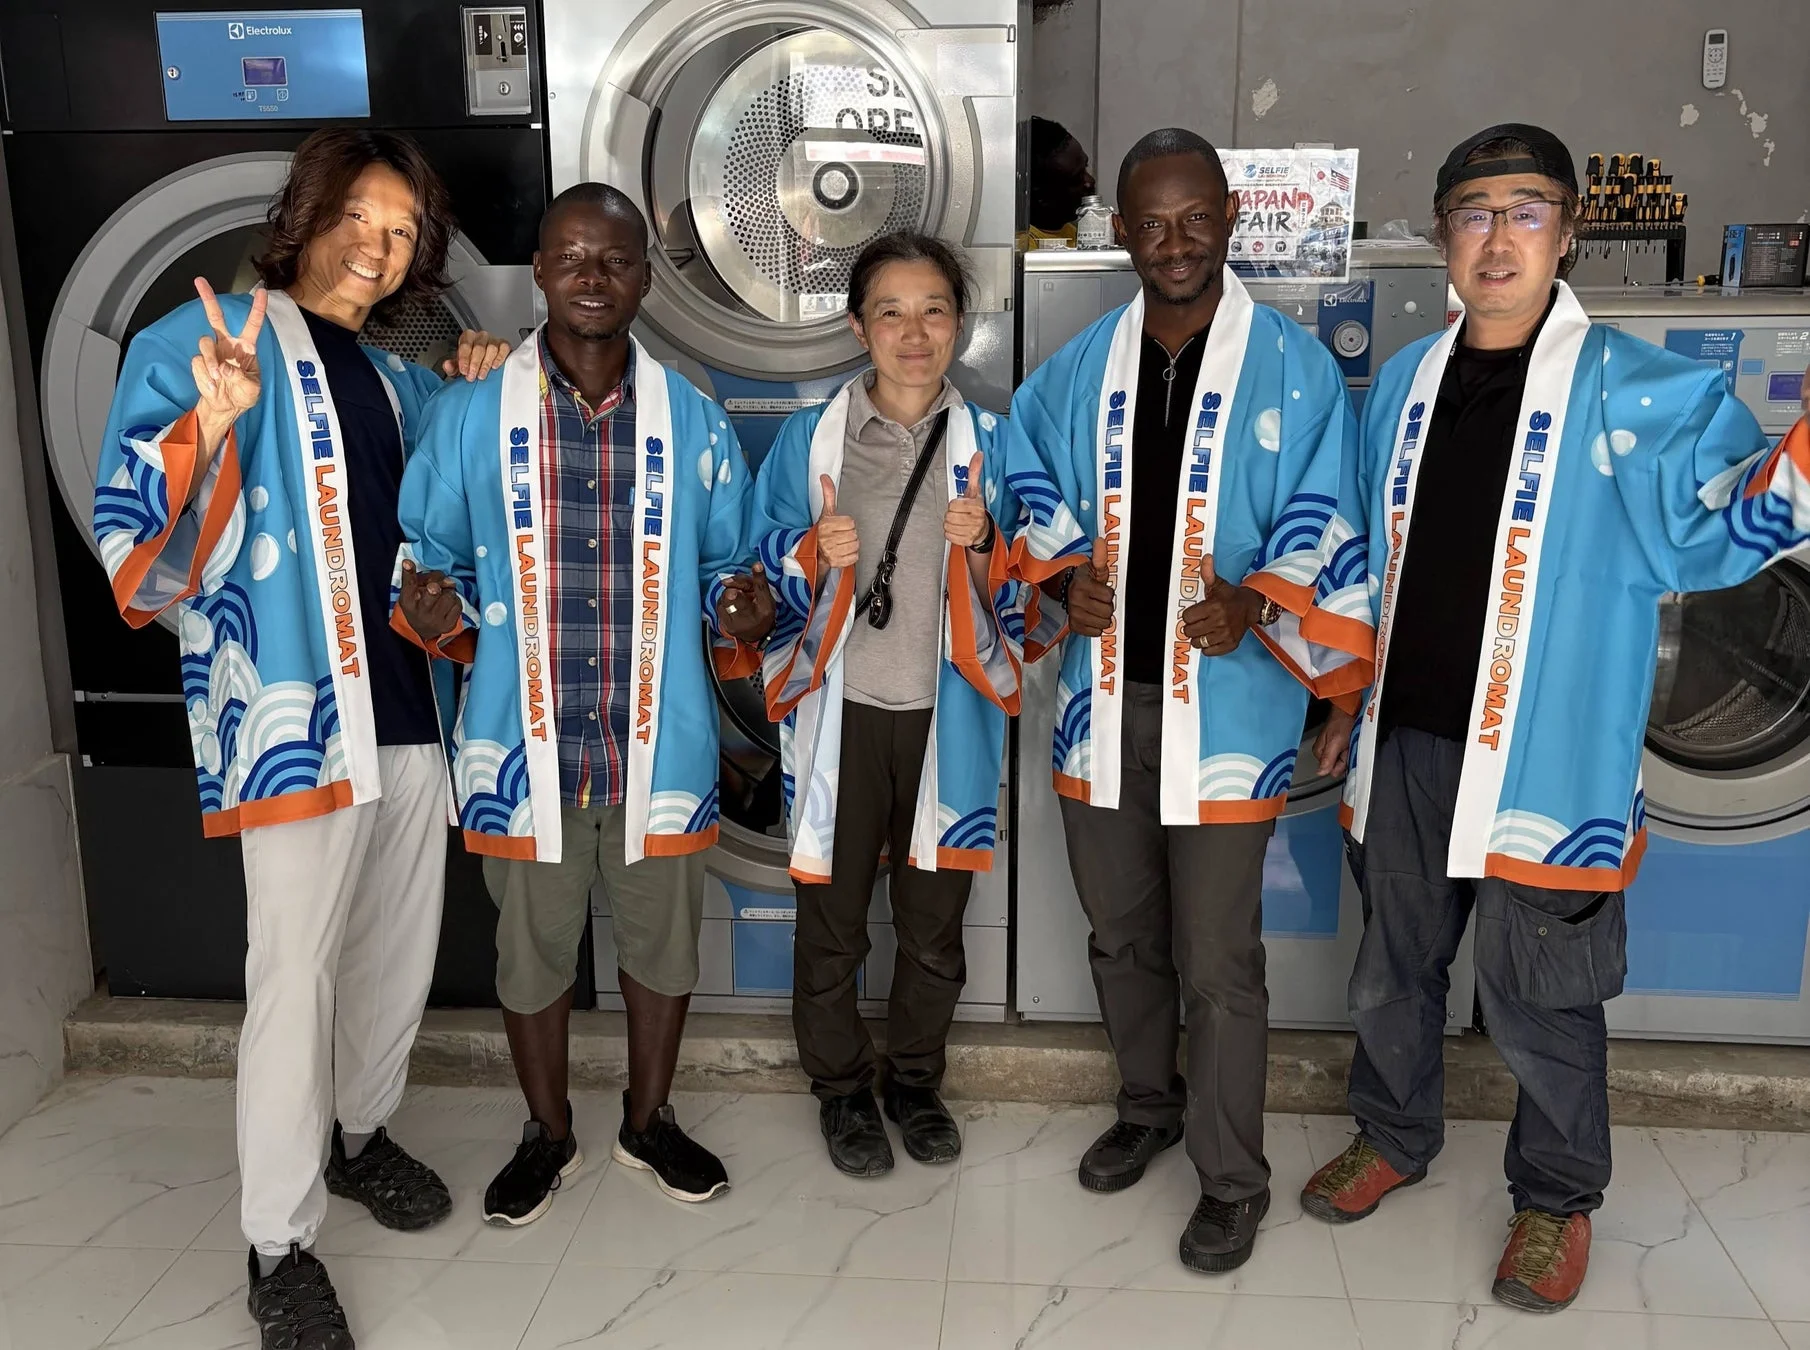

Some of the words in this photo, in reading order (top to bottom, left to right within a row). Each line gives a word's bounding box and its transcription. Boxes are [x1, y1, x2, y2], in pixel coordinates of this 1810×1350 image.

[246, 26, 292, 35] Electrolux
[1259, 166, 1290, 174] SELFIE
[1235, 211, 1293, 233] FAIR
[1799, 331, 1809, 340] 2
[509, 426, 533, 529] SELFIE
[643, 436, 665, 536] SELFIE
[1104, 390, 1127, 489] SELFIE
[1188, 391, 1222, 493] SELFIE
[1391, 401, 1426, 507] SELFIE
[1511, 410, 1552, 523] SELFIE
[296, 360, 334, 460] SELFIE
[315, 464, 361, 678] LAUNDROMAT
[515, 534, 547, 742] LAUNDROMAT
[635, 541, 661, 745] LAUNDROMAT
[1099, 495, 1121, 696] LAUNDOMAT
[1478, 526, 1531, 751] LAUNDROMAT
